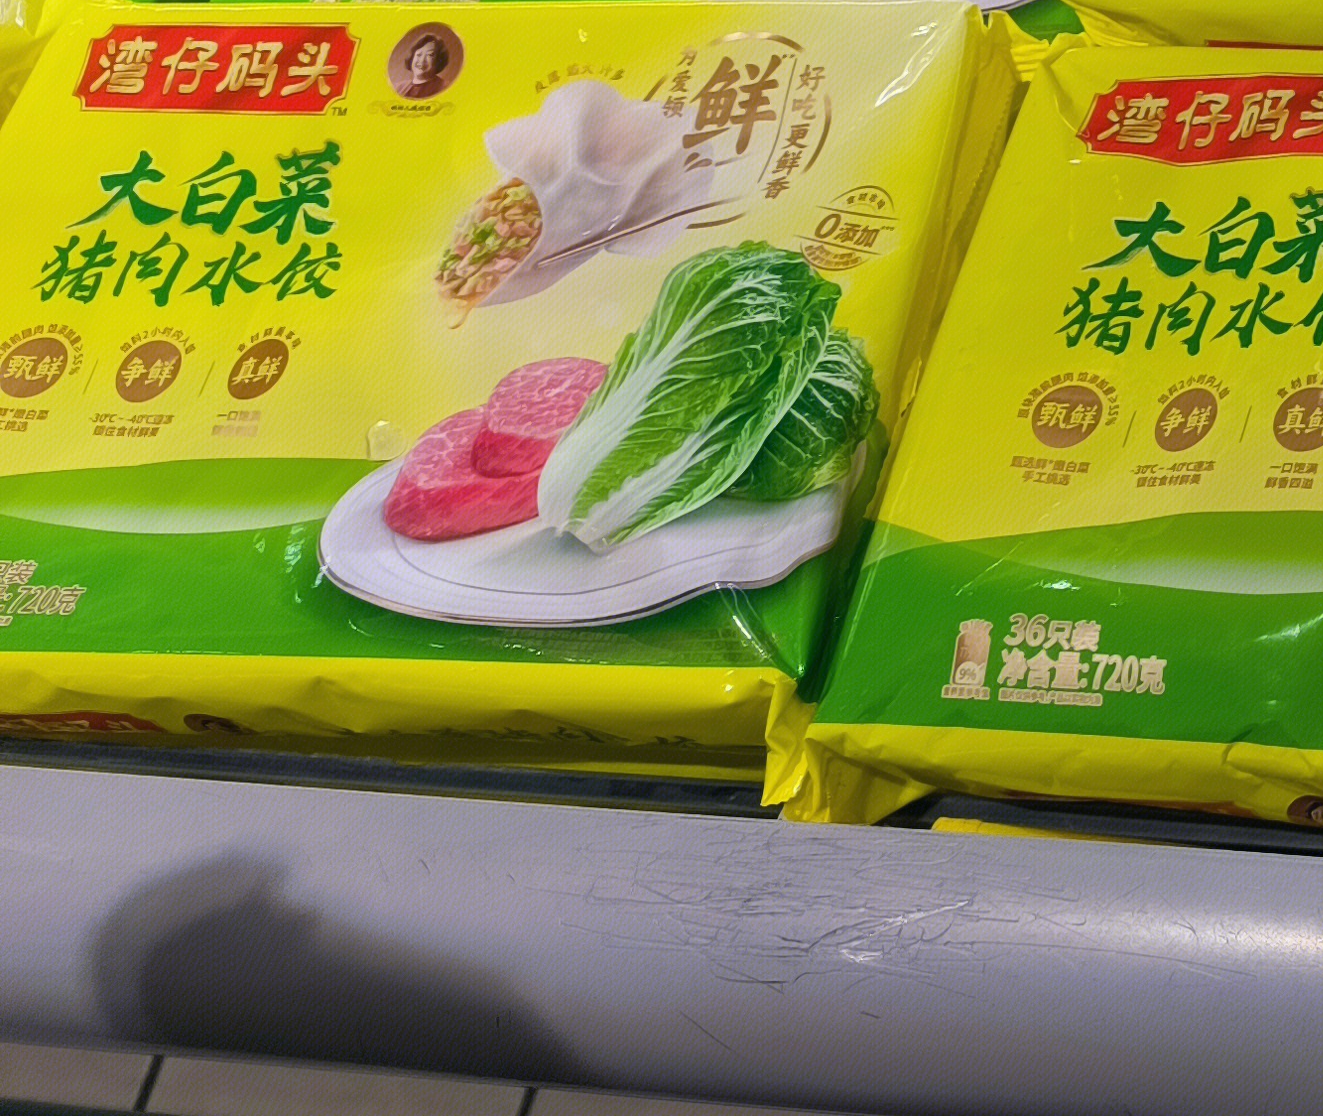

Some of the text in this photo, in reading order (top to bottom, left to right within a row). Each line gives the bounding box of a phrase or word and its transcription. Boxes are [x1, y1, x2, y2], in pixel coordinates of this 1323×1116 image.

[89, 35, 339, 97] 湾仔码头
[682, 54, 783, 155] 鲜
[761, 64, 827, 201] 好吃更鲜香
[64, 138, 342, 246] 大白菜
[813, 212, 882, 250] 0添加
[31, 229, 344, 307] 猪肉水饺
[4, 354, 65, 382] 甄鲜
[121, 355, 179, 388] 争鲜
[231, 355, 283, 385] 真鲜
[1036, 401, 1098, 433] 甄鲜
[1159, 403, 1214, 437] 争鲜
[1002, 613, 1102, 652] 36只装
[997, 647, 1168, 695] 净含量:720克
